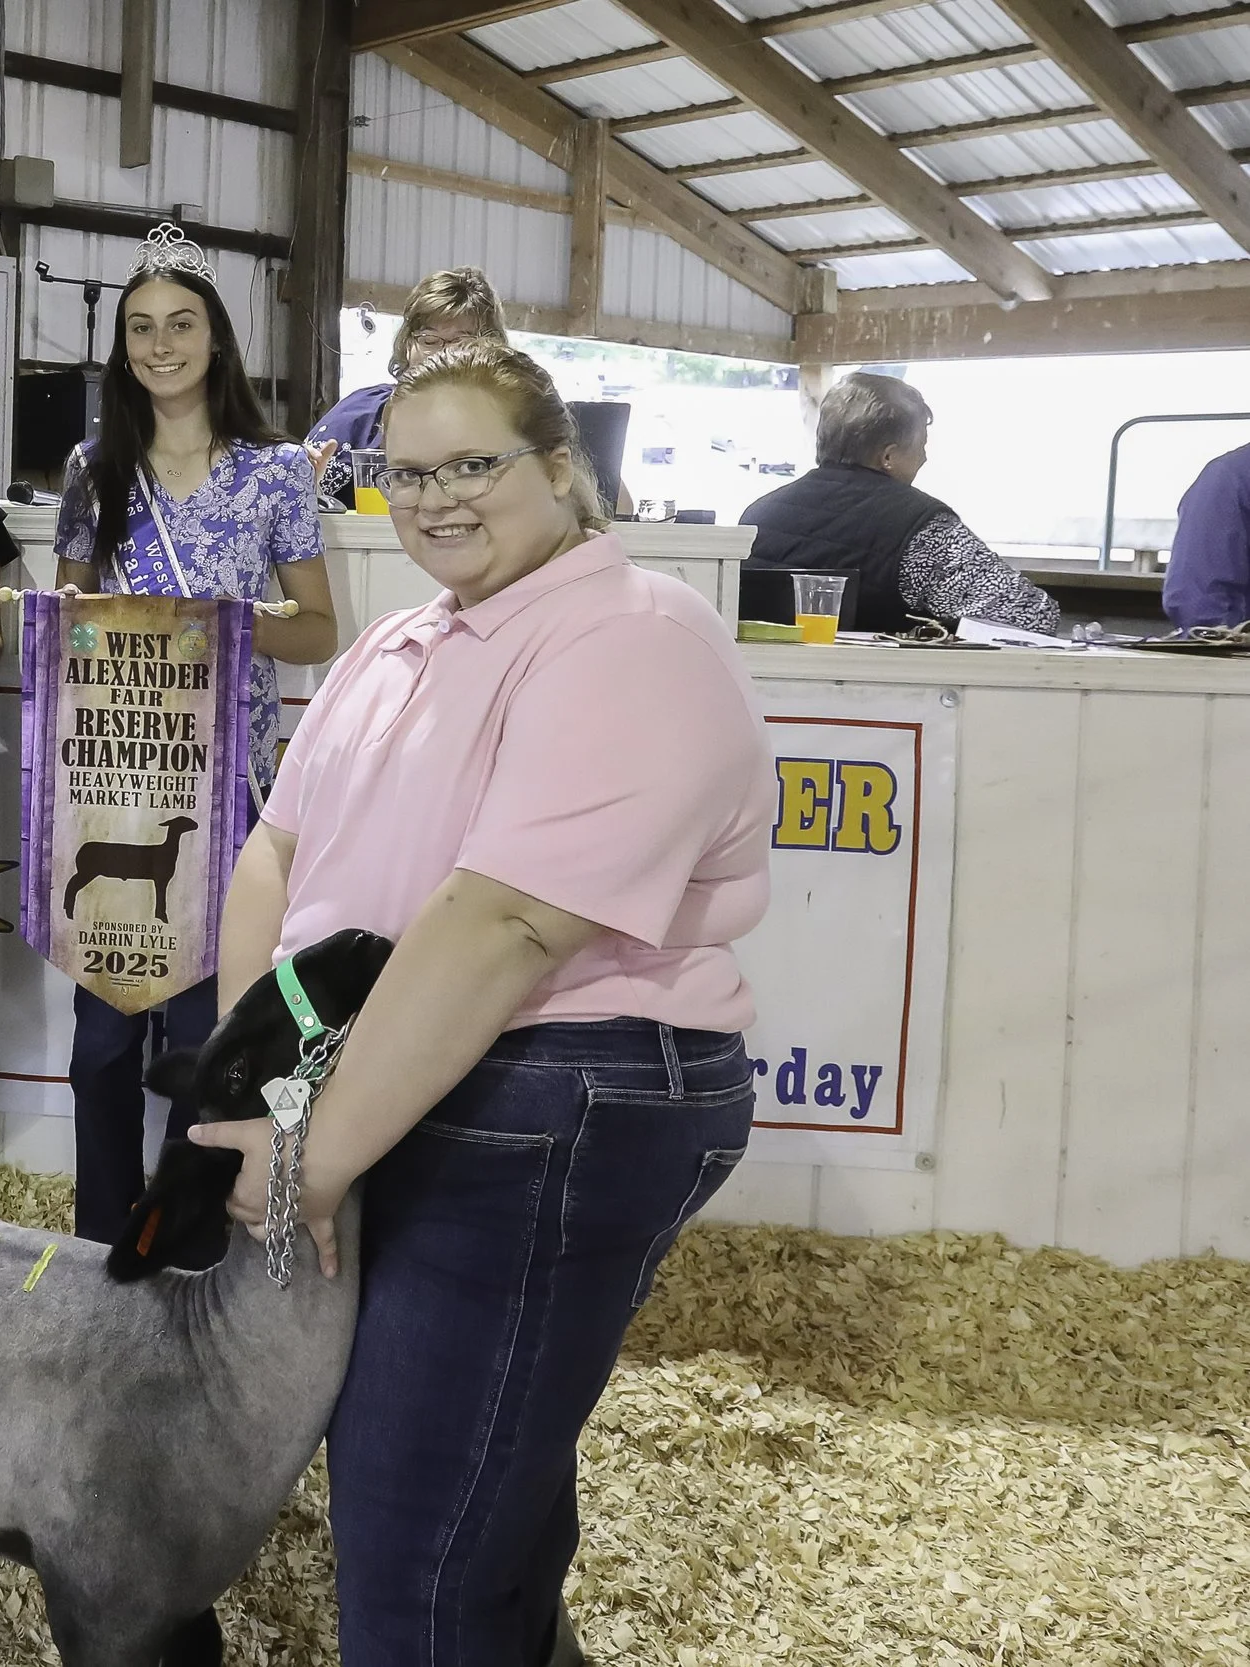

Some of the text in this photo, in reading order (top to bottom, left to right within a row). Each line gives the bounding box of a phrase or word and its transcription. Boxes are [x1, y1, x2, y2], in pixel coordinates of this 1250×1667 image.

[117, 537, 150, 596] Fair
[145, 538, 176, 595] West
[106, 632, 172, 660] WEST
[65, 658, 210, 690] ALEXANDER
[110, 688, 163, 706] FAIR
[75, 708, 196, 741] RESERVE
[62, 738, 208, 772] CHAMPION
[69, 772, 198, 792] HEAVYWEIGHT
[70, 789, 196, 810] MARKET LAMB
[770, 757, 902, 855] ER
[78, 930, 177, 950] DARRIN LYLE
[93, 922, 164, 934] SPONSORED BY
[84, 950, 169, 978] 2025
